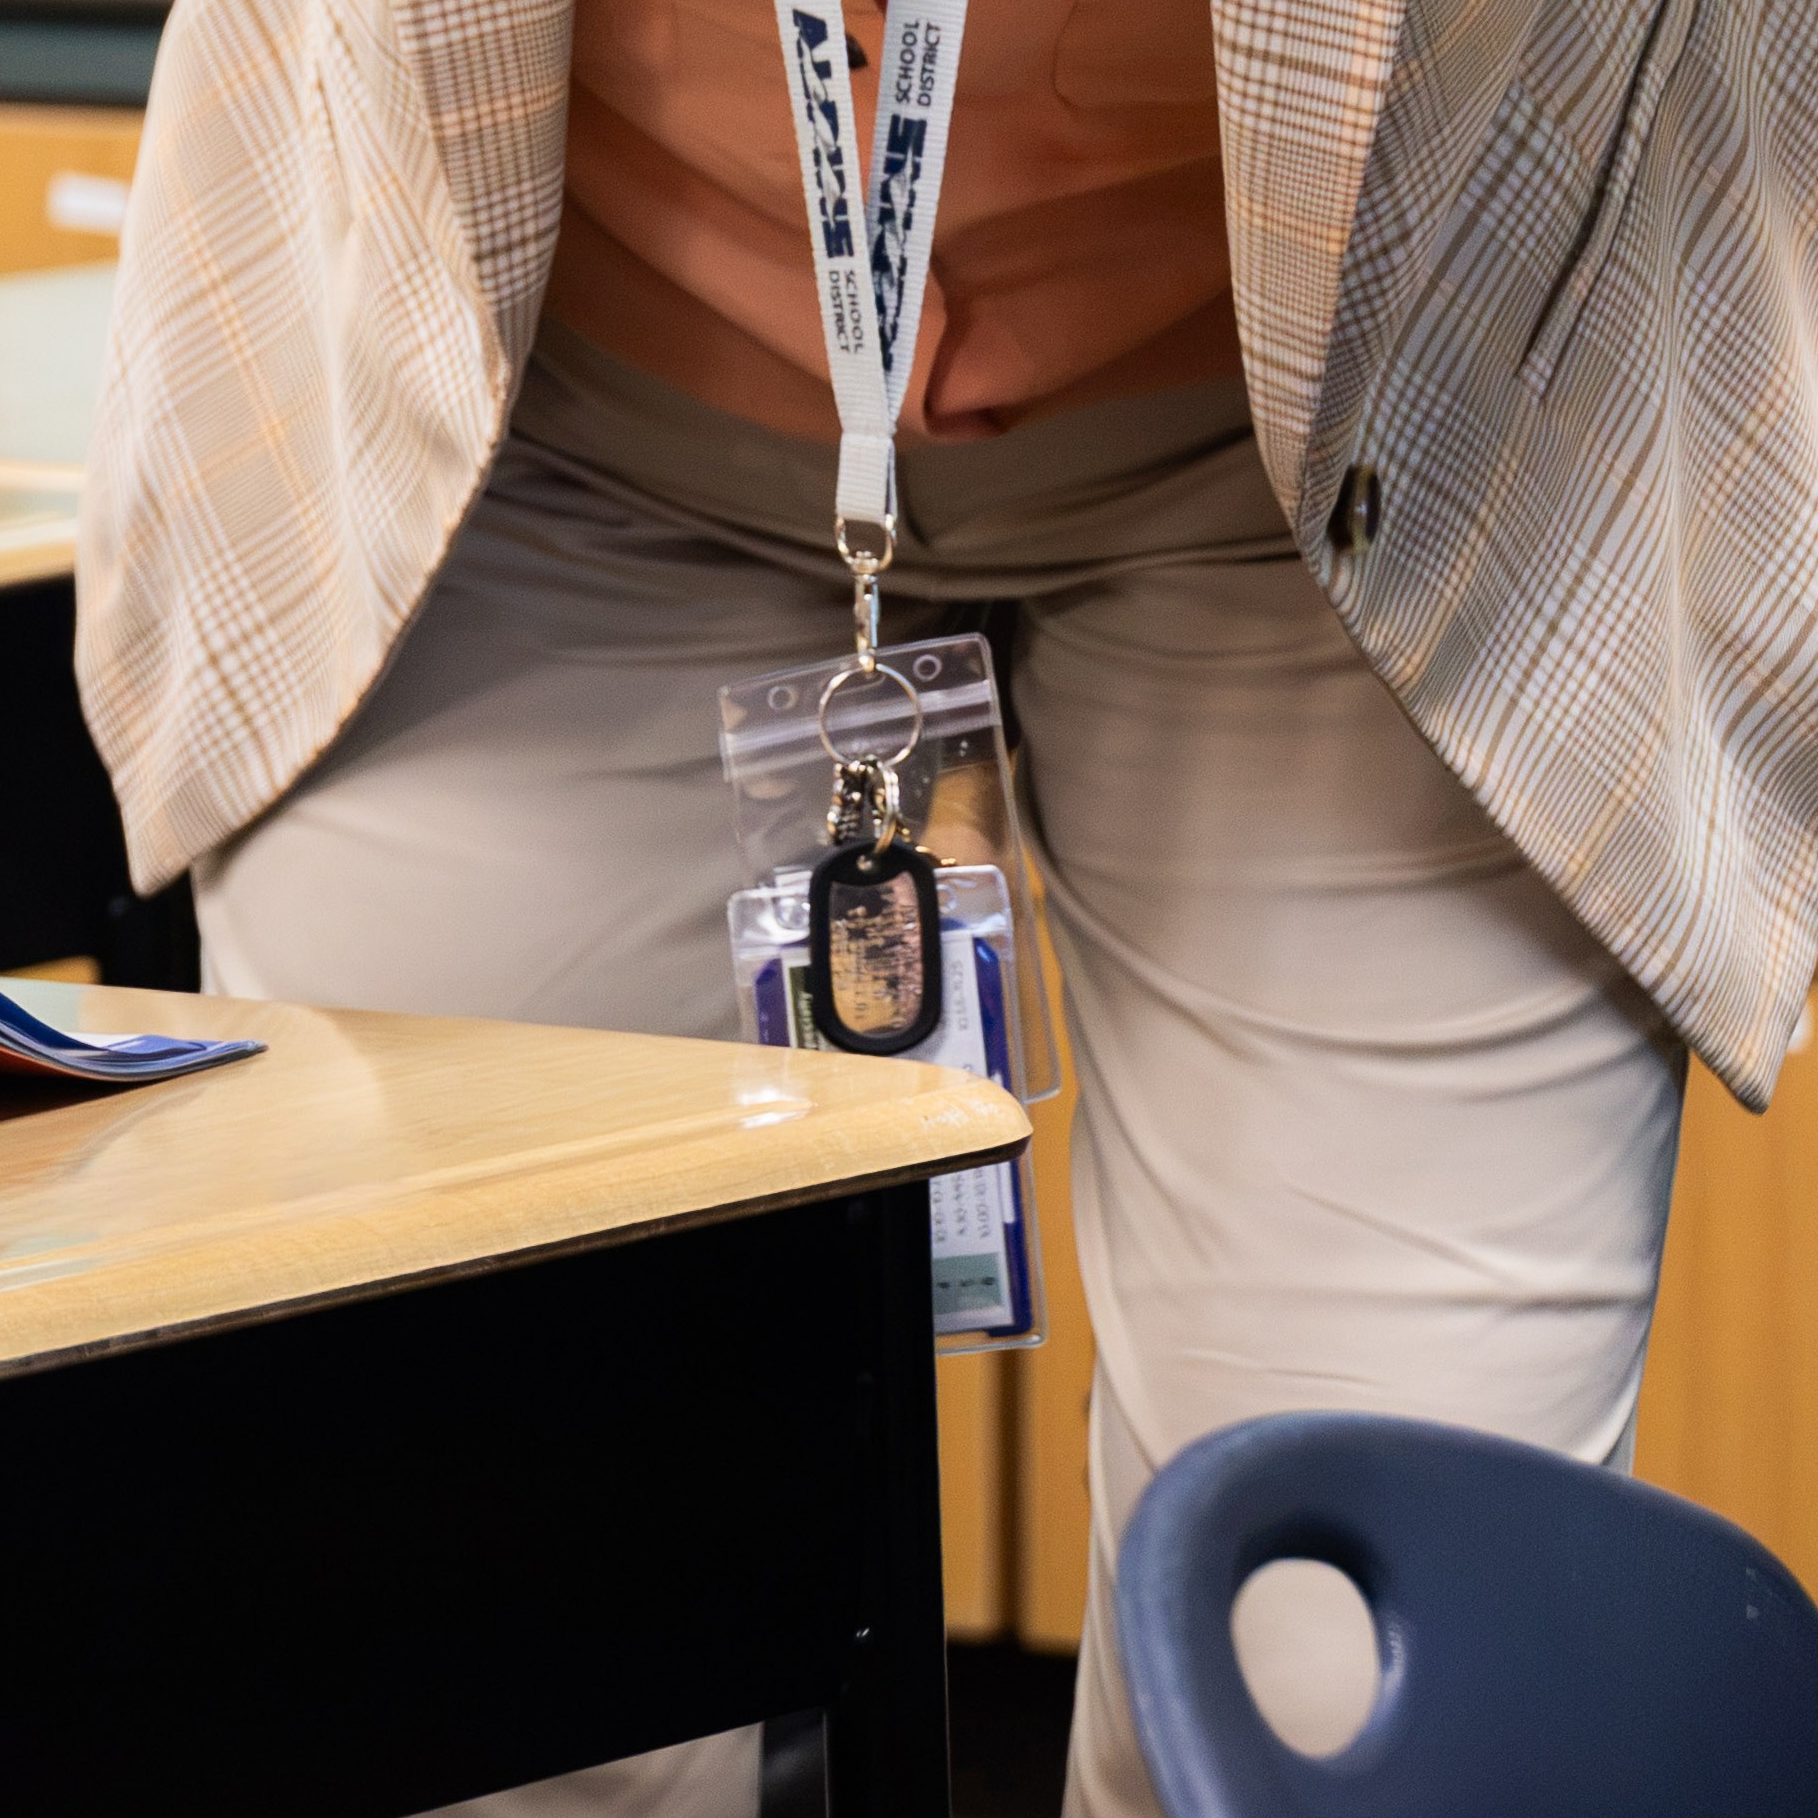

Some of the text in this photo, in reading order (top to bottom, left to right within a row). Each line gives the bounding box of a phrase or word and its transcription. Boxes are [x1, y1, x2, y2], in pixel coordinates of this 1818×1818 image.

[894, 19, 921, 103] SCHOOL
[917, 22, 943, 108] DISTRICT
[827, 270, 851, 354] DISTRICT
[843, 268, 864, 354] SCHOOL
